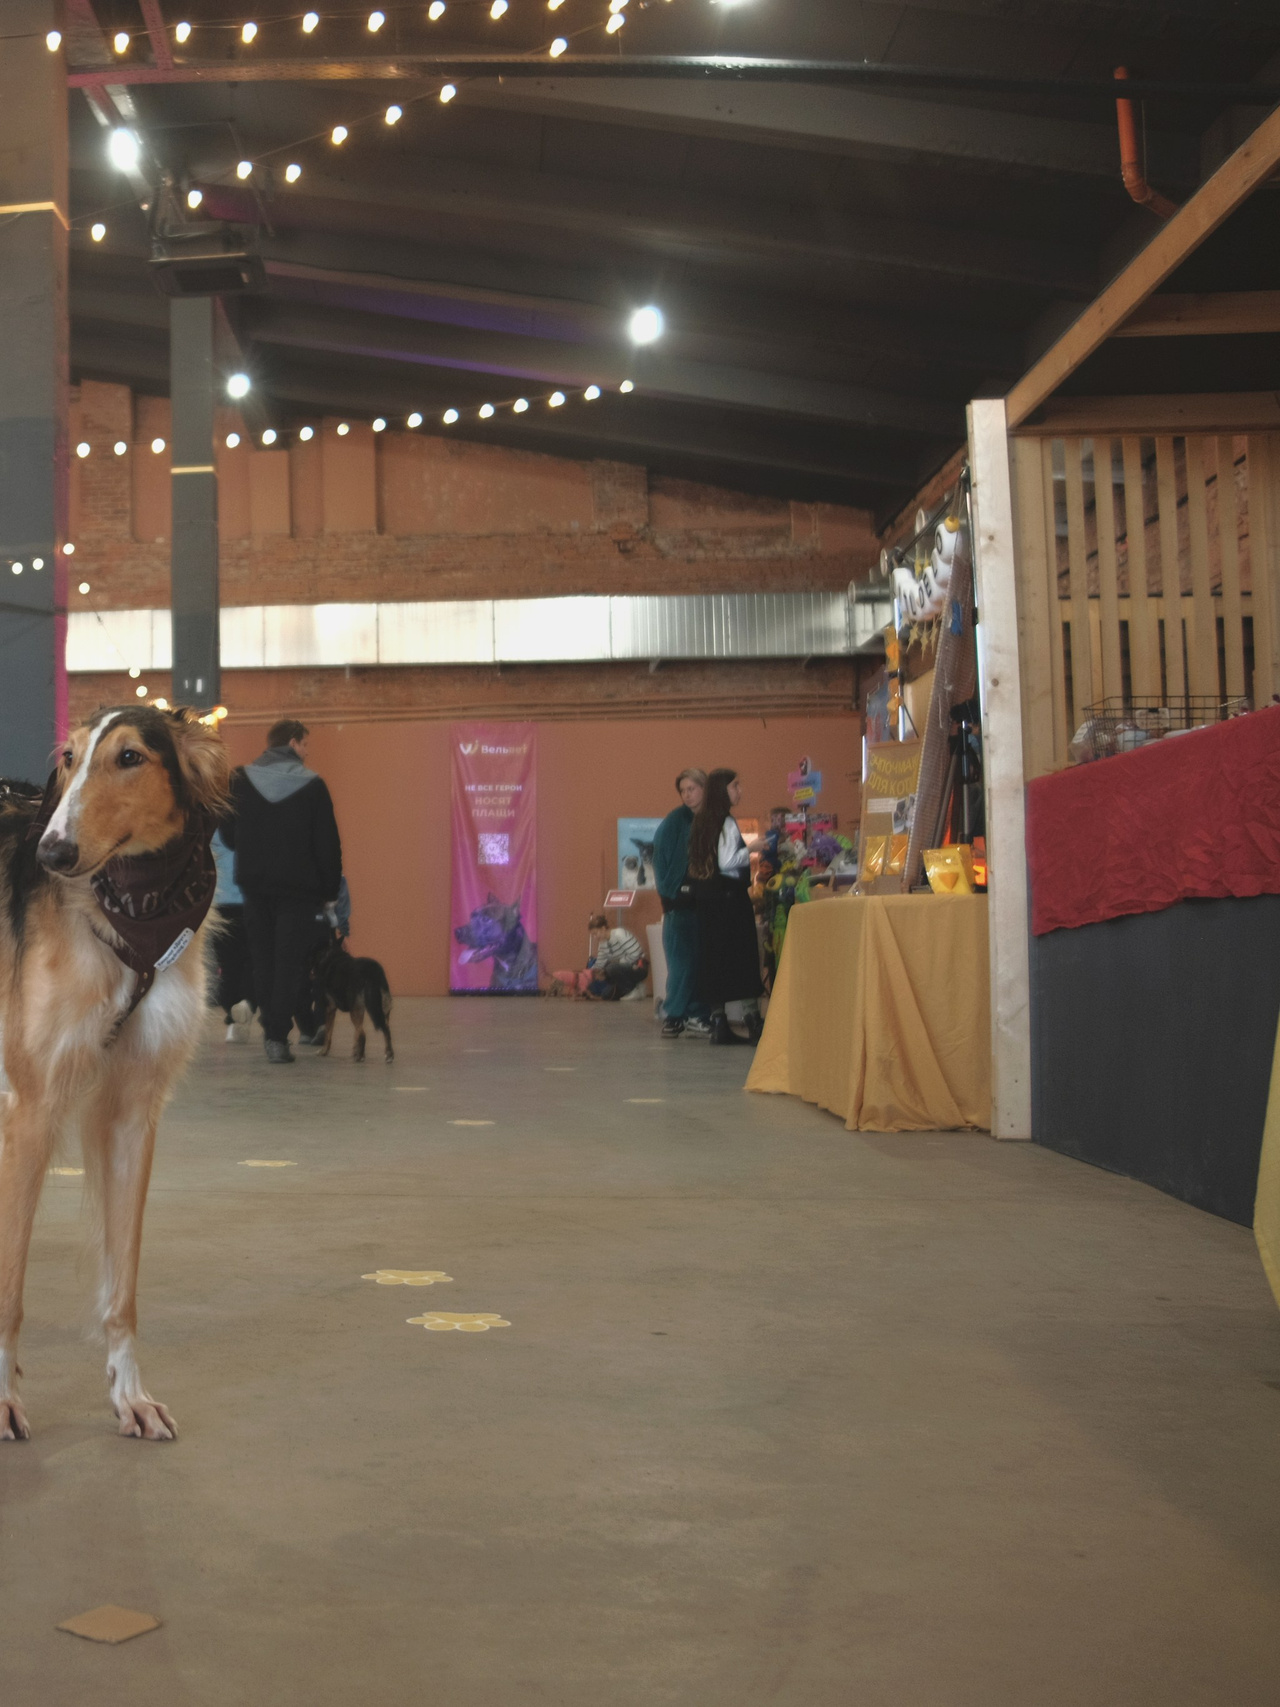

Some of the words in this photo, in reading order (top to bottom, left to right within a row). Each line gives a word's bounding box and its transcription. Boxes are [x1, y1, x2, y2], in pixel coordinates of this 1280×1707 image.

[868, 771, 889, 794] ДЛЯ
[465, 784, 476, 792] НЕ
[477, 784, 493, 792] ВСЕ
[495, 784, 523, 792] ГЕРОИ
[475, 796, 512, 806] НОСЯТ
[472, 809, 516, 818] ПЛАЩИ
